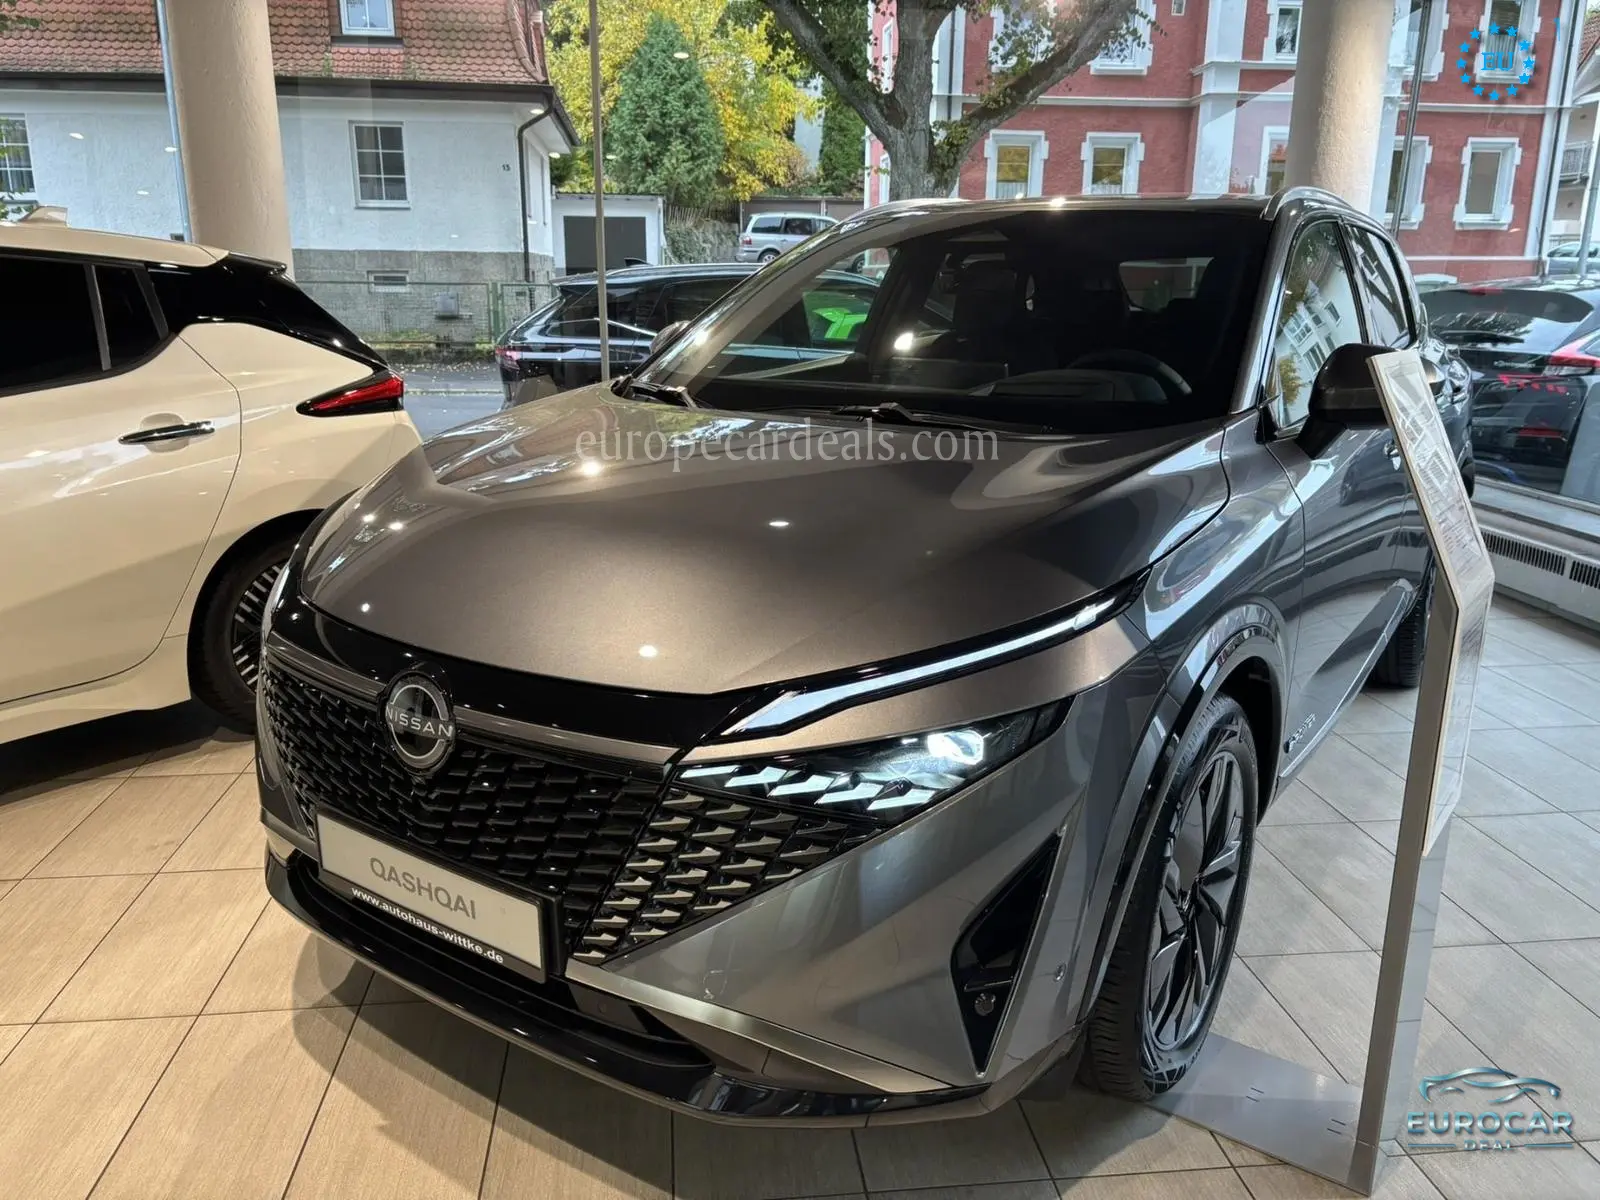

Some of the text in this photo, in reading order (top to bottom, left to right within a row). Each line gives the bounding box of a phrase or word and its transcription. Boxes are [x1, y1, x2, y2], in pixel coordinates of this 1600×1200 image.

[385, 703, 453, 737] NISSAN
[369, 857, 476, 920] QASHQAI
[351, 887, 504, 964] www.autohaus-wittke.de
